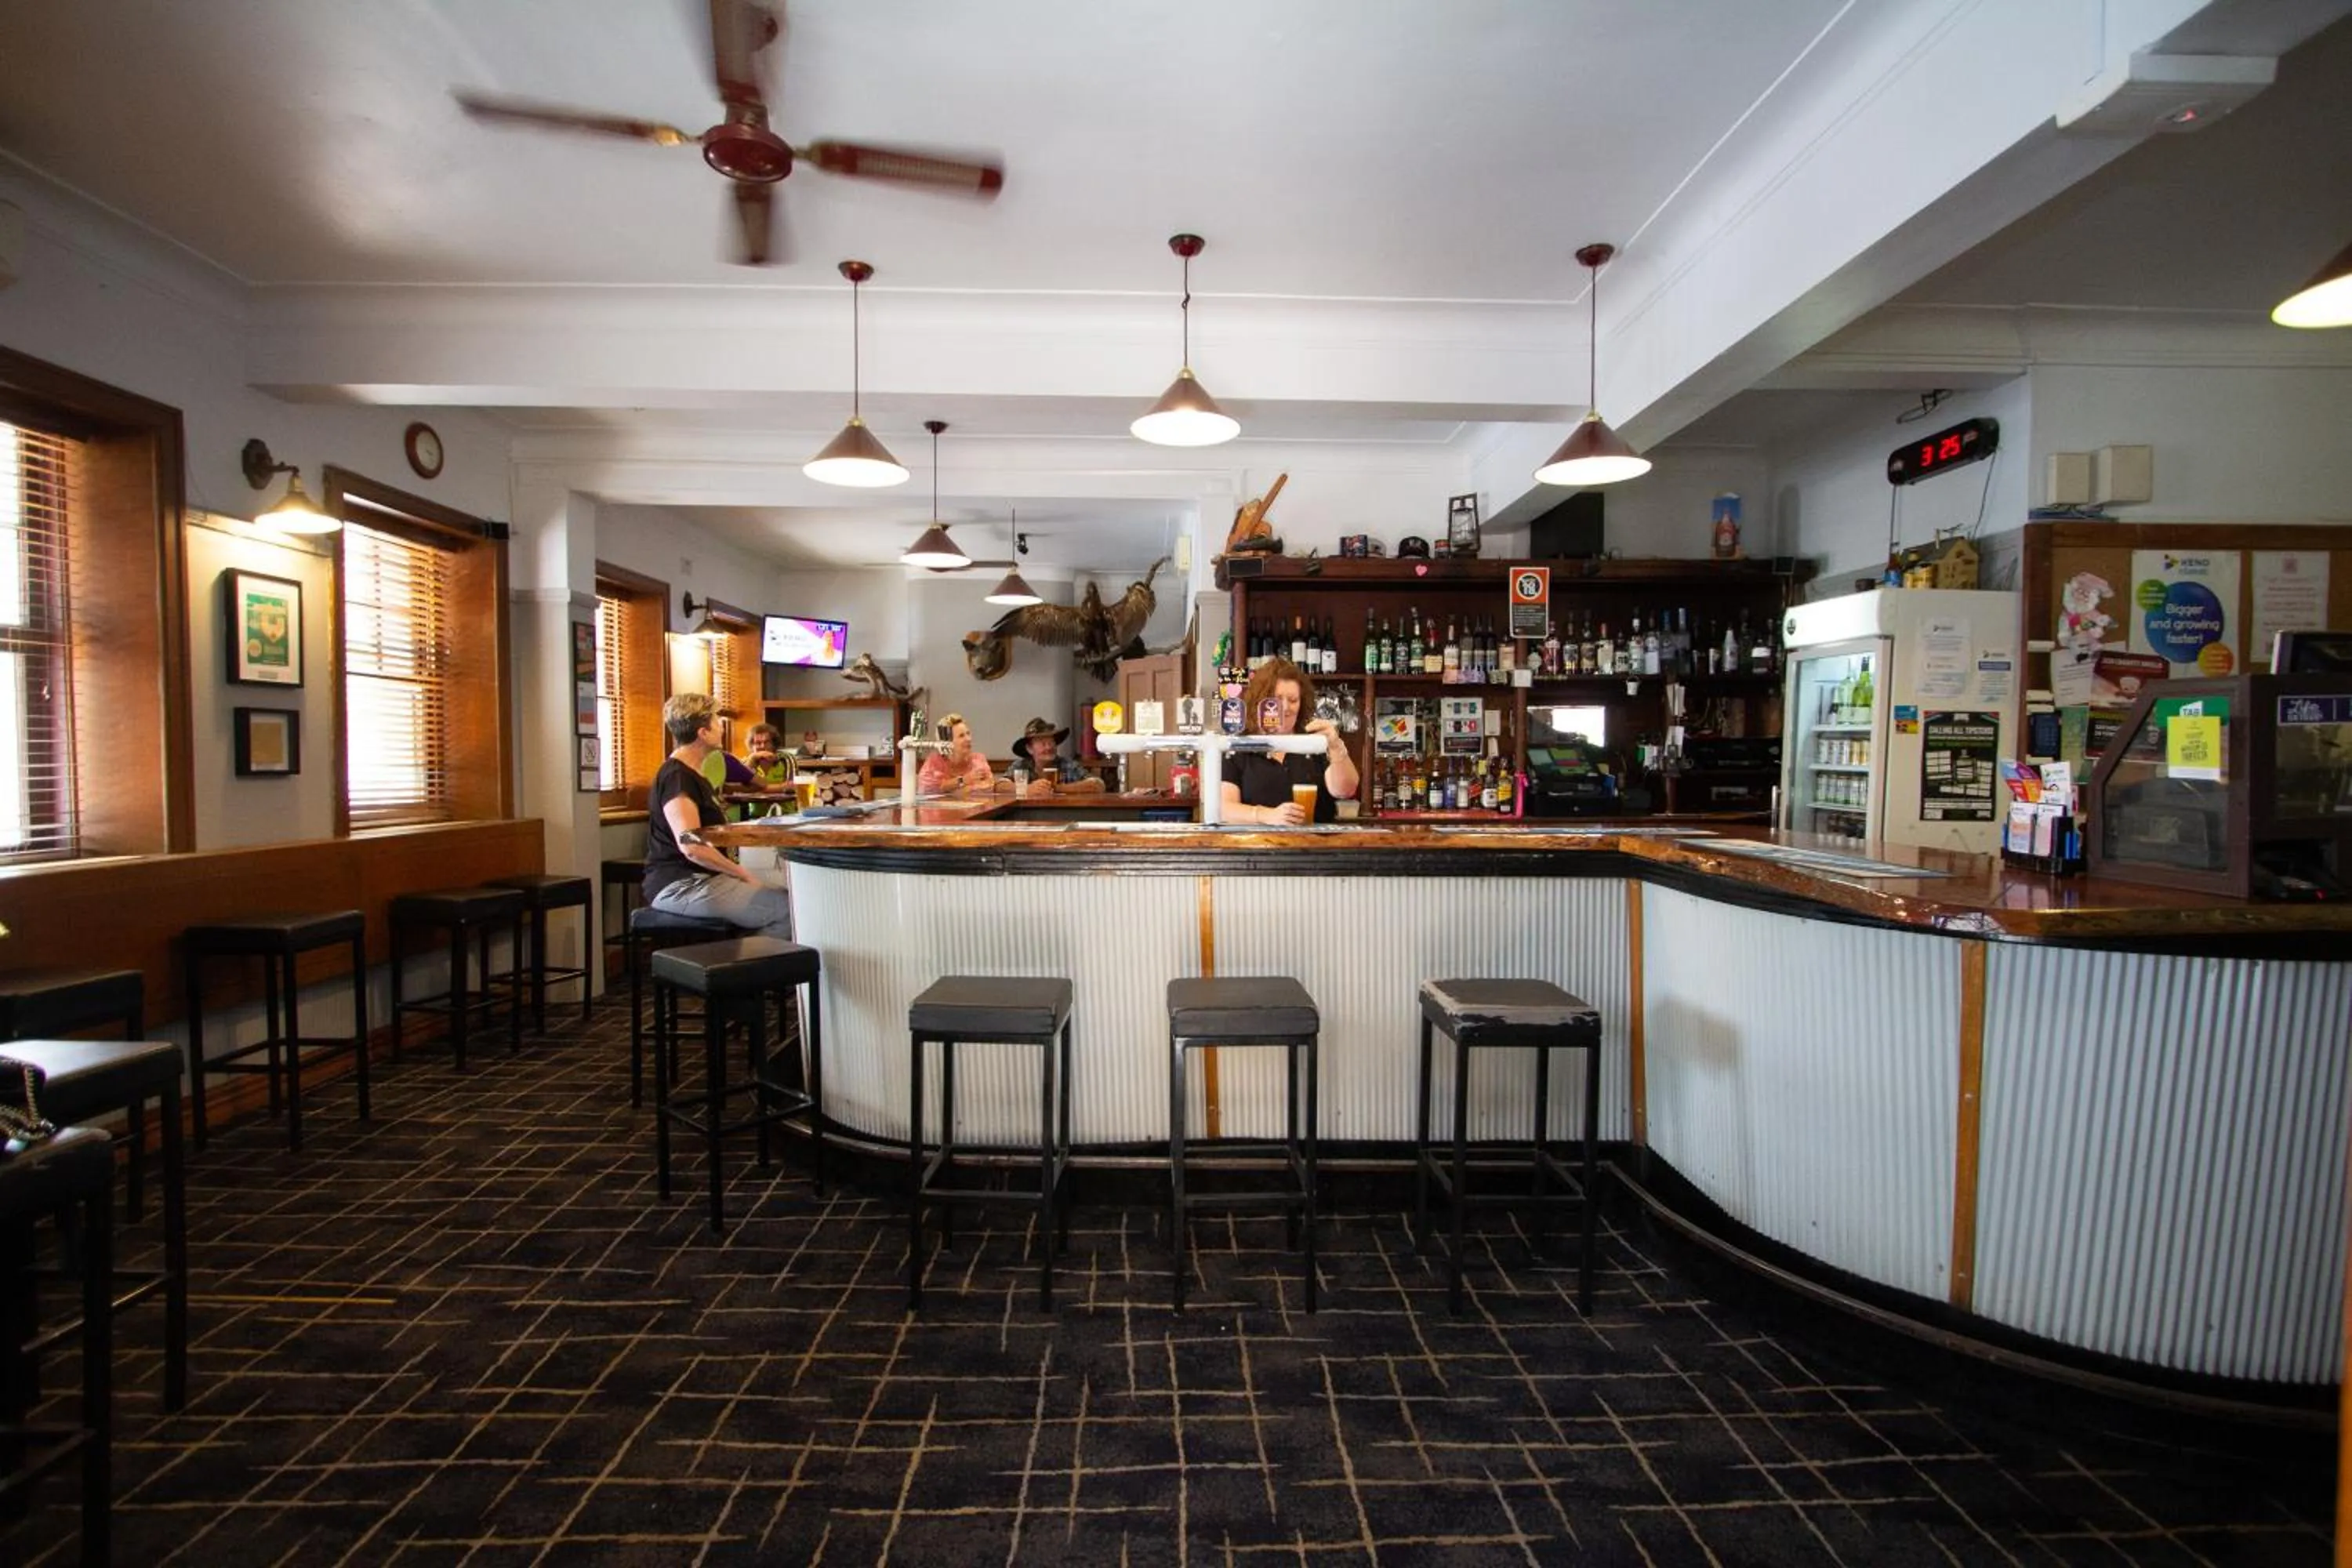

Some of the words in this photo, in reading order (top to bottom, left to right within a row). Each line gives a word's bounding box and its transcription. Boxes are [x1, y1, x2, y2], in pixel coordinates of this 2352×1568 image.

[2180, 558, 2210, 567] KENO
[2165, 603, 2205, 616] Bigger
[2148, 619, 2171, 629] and
[2173, 619, 2220, 631] growing
[2166, 633, 2204, 644] faster!
